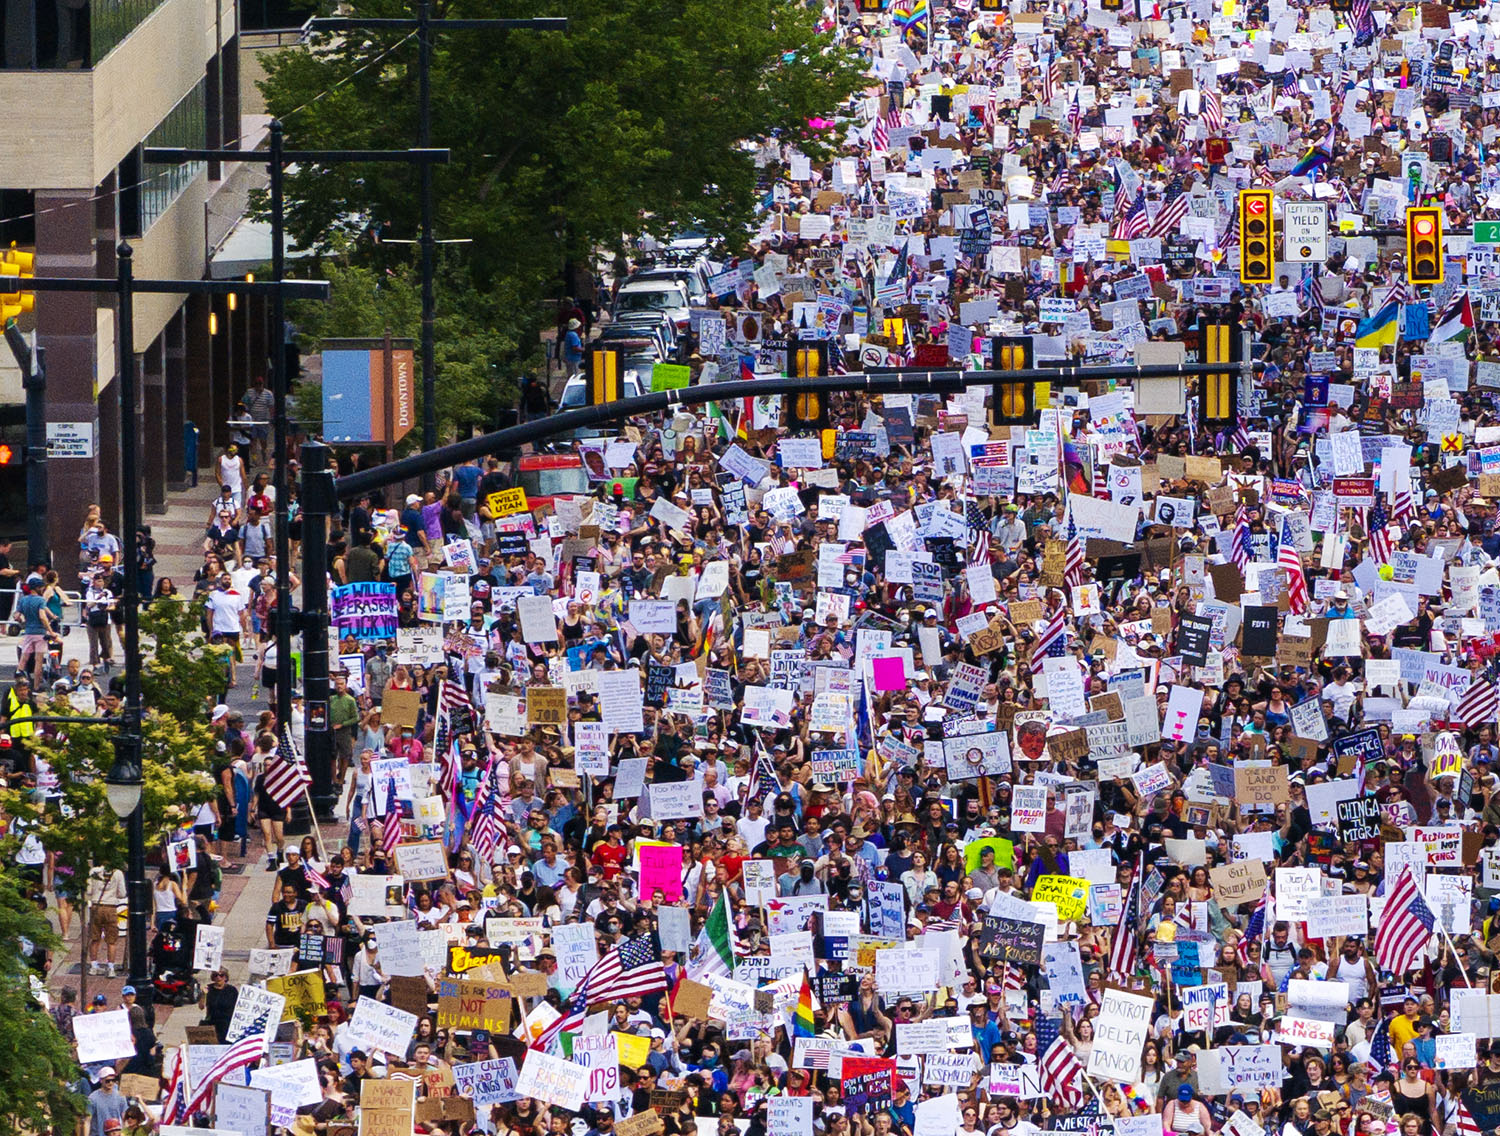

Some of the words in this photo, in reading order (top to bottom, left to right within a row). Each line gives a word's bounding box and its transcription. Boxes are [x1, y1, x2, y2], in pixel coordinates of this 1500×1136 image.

[1292, 215, 1319, 225] YIELD
[399, 361, 409, 427] DOWNTOWN
[494, 494, 520, 505] WILD
[495, 501, 523, 513] UTAH
[812, 750, 857, 762] DEMOCRACY
[812, 761, 834, 773] DIES
[835, 759, 857, 771] WHILE
[813, 770, 840, 783] TRUMP
[1338, 799, 1380, 821] CHINGA
[1343, 823, 1381, 843] MIGRA
[440, 981, 458, 998] ICE
[460, 984, 468, 996] IS
[473, 986, 485, 997] FOR
[486, 987, 512, 1000] SODA
[460, 999, 487, 1015] NOT
[1102, 997, 1149, 1021] FOXTROT
[438, 1011, 504, 1033] HUMANS
[1098, 1023, 1141, 1046] DELTA
[1093, 1050, 1134, 1073] TANGO
